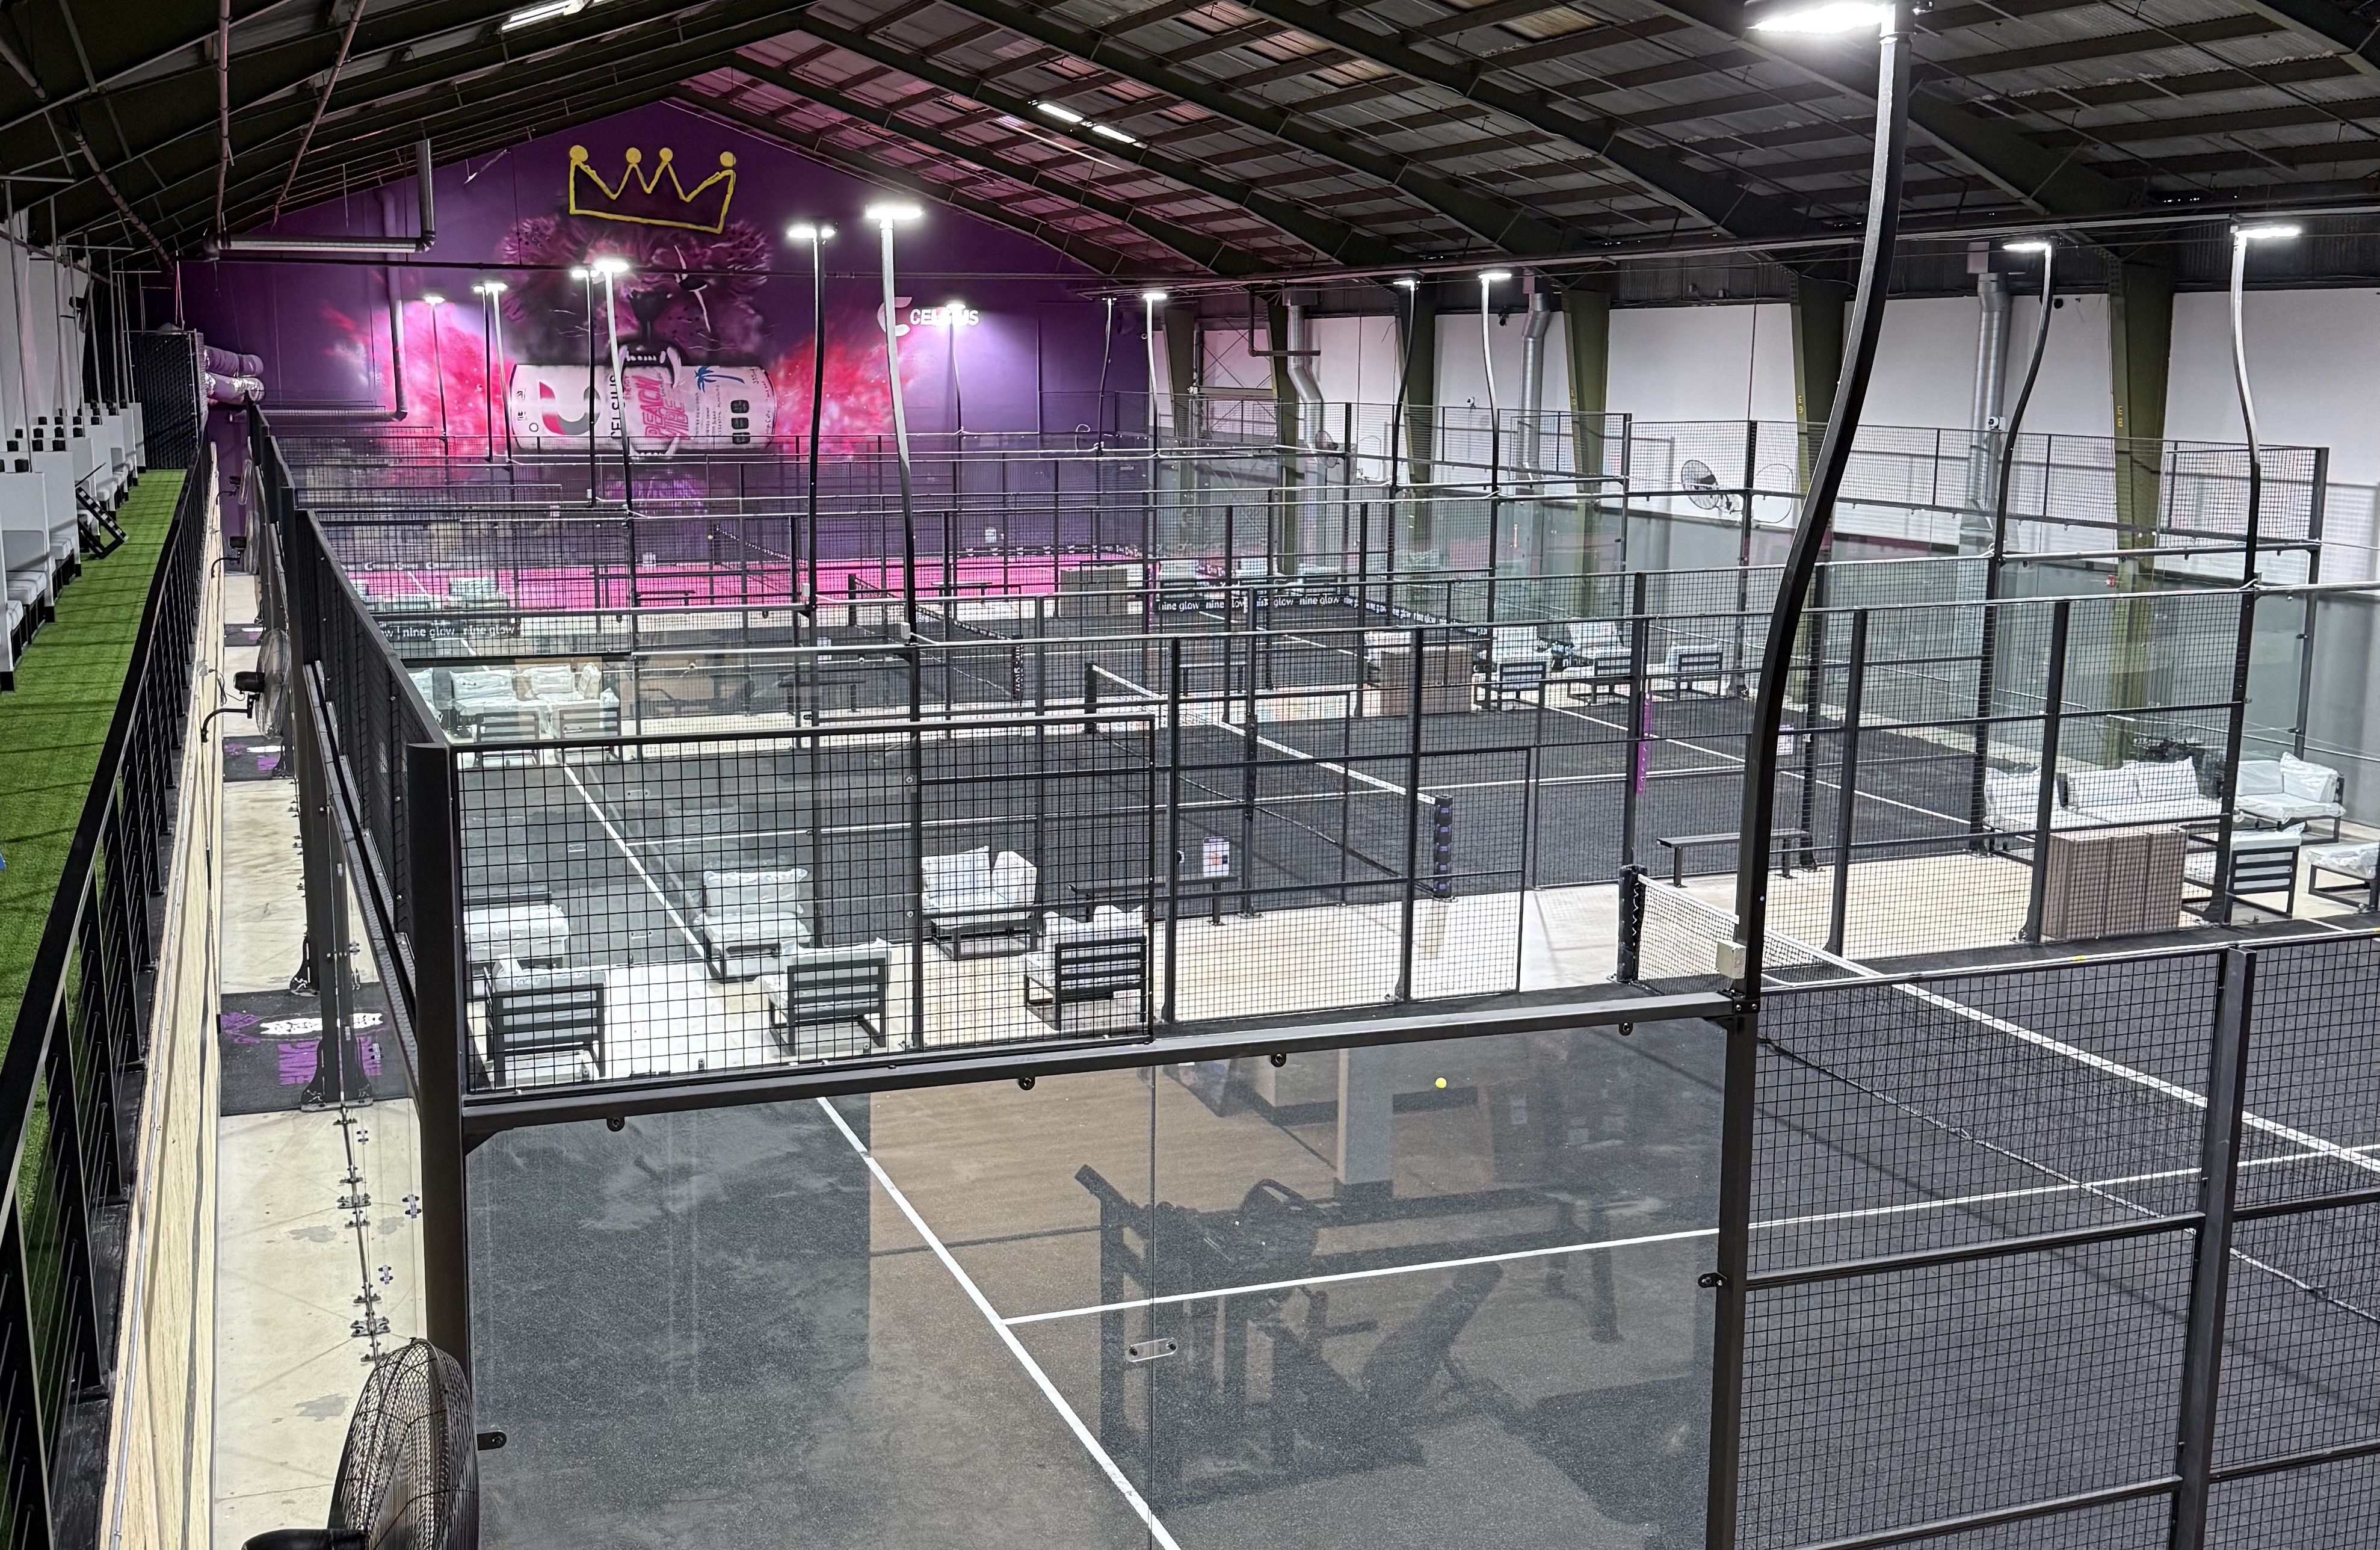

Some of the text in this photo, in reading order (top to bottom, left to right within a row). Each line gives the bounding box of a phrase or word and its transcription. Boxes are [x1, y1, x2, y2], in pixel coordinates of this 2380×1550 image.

[910, 308, 979, 326] CELUS
[631, 375, 665, 438] PEACH
[1179, 601, 1200, 612] glow
[1206, 600, 1224, 609] nine
[1299, 596, 1318, 605] nine
[402, 628, 427, 638] nine
